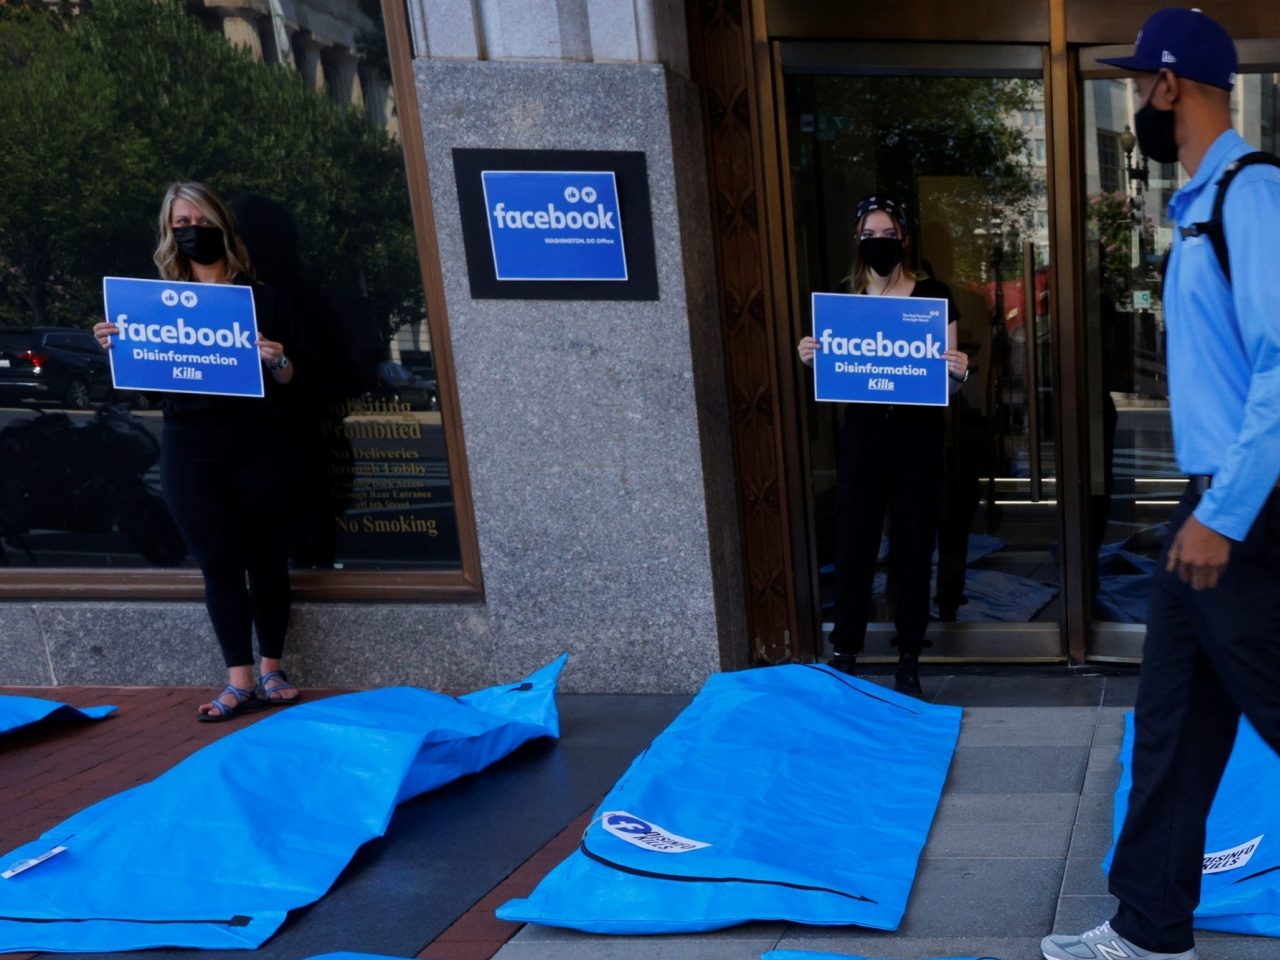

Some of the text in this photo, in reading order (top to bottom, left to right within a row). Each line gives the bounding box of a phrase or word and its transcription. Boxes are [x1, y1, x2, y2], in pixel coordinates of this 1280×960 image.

[493, 202, 615, 230] facebook
[114, 314, 252, 349] facebook
[819, 328, 943, 359] facebook
[133, 348, 238, 366] Disinformation
[172, 366, 203, 380] Kills
[834, 362, 927, 376] Disinformation
[867, 378, 895, 390] Kills
[353, 447, 419, 460] Deliveries
[335, 515, 438, 537] No Smoking
[632, 835, 673, 850] KILLS
